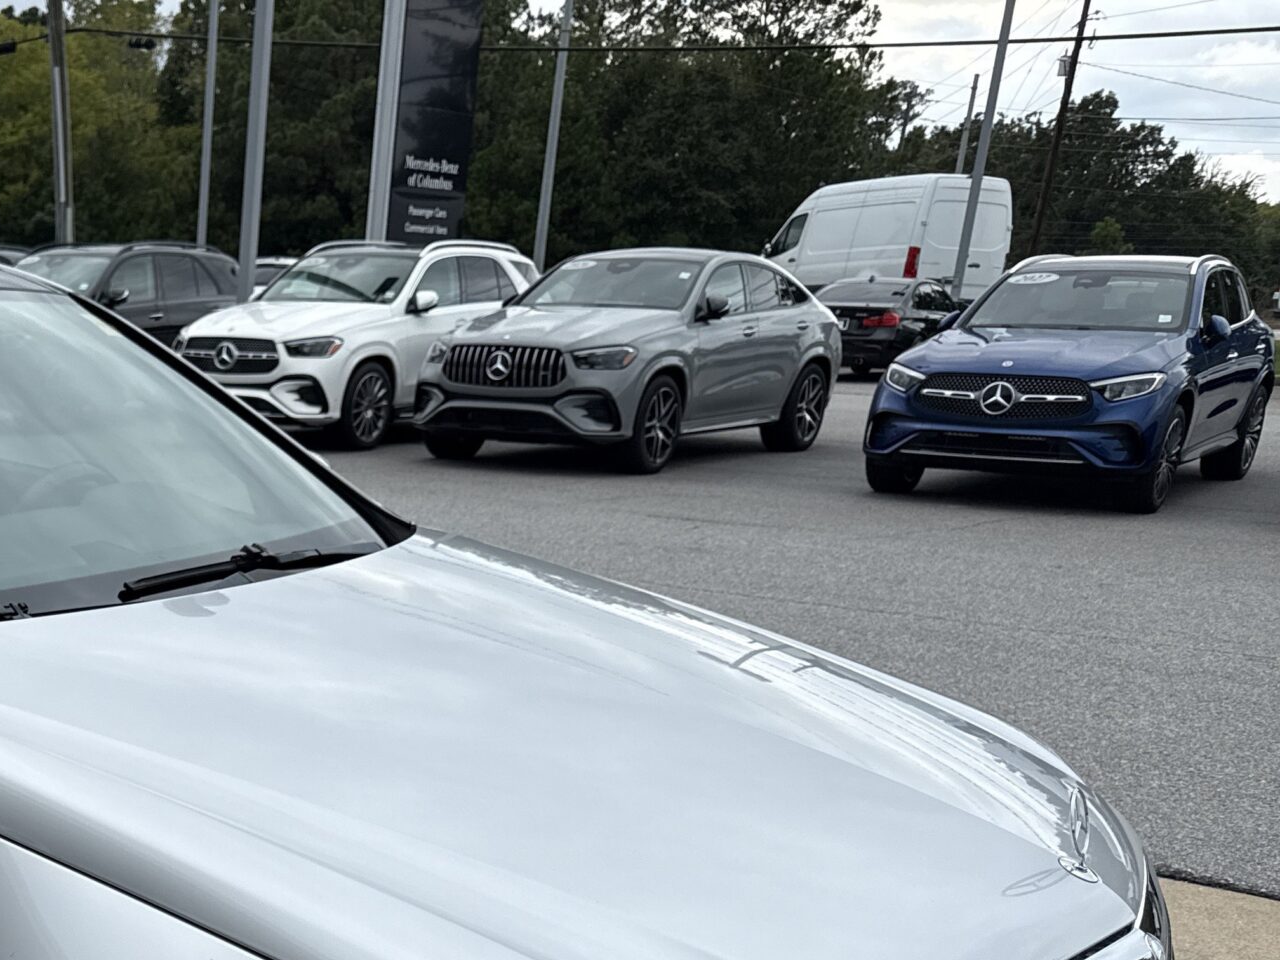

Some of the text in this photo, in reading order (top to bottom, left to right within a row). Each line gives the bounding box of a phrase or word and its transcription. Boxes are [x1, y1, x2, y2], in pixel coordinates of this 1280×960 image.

[405, 155, 459, 175] Mercedes-Benz
[408, 173, 453, 190] of Columbus
